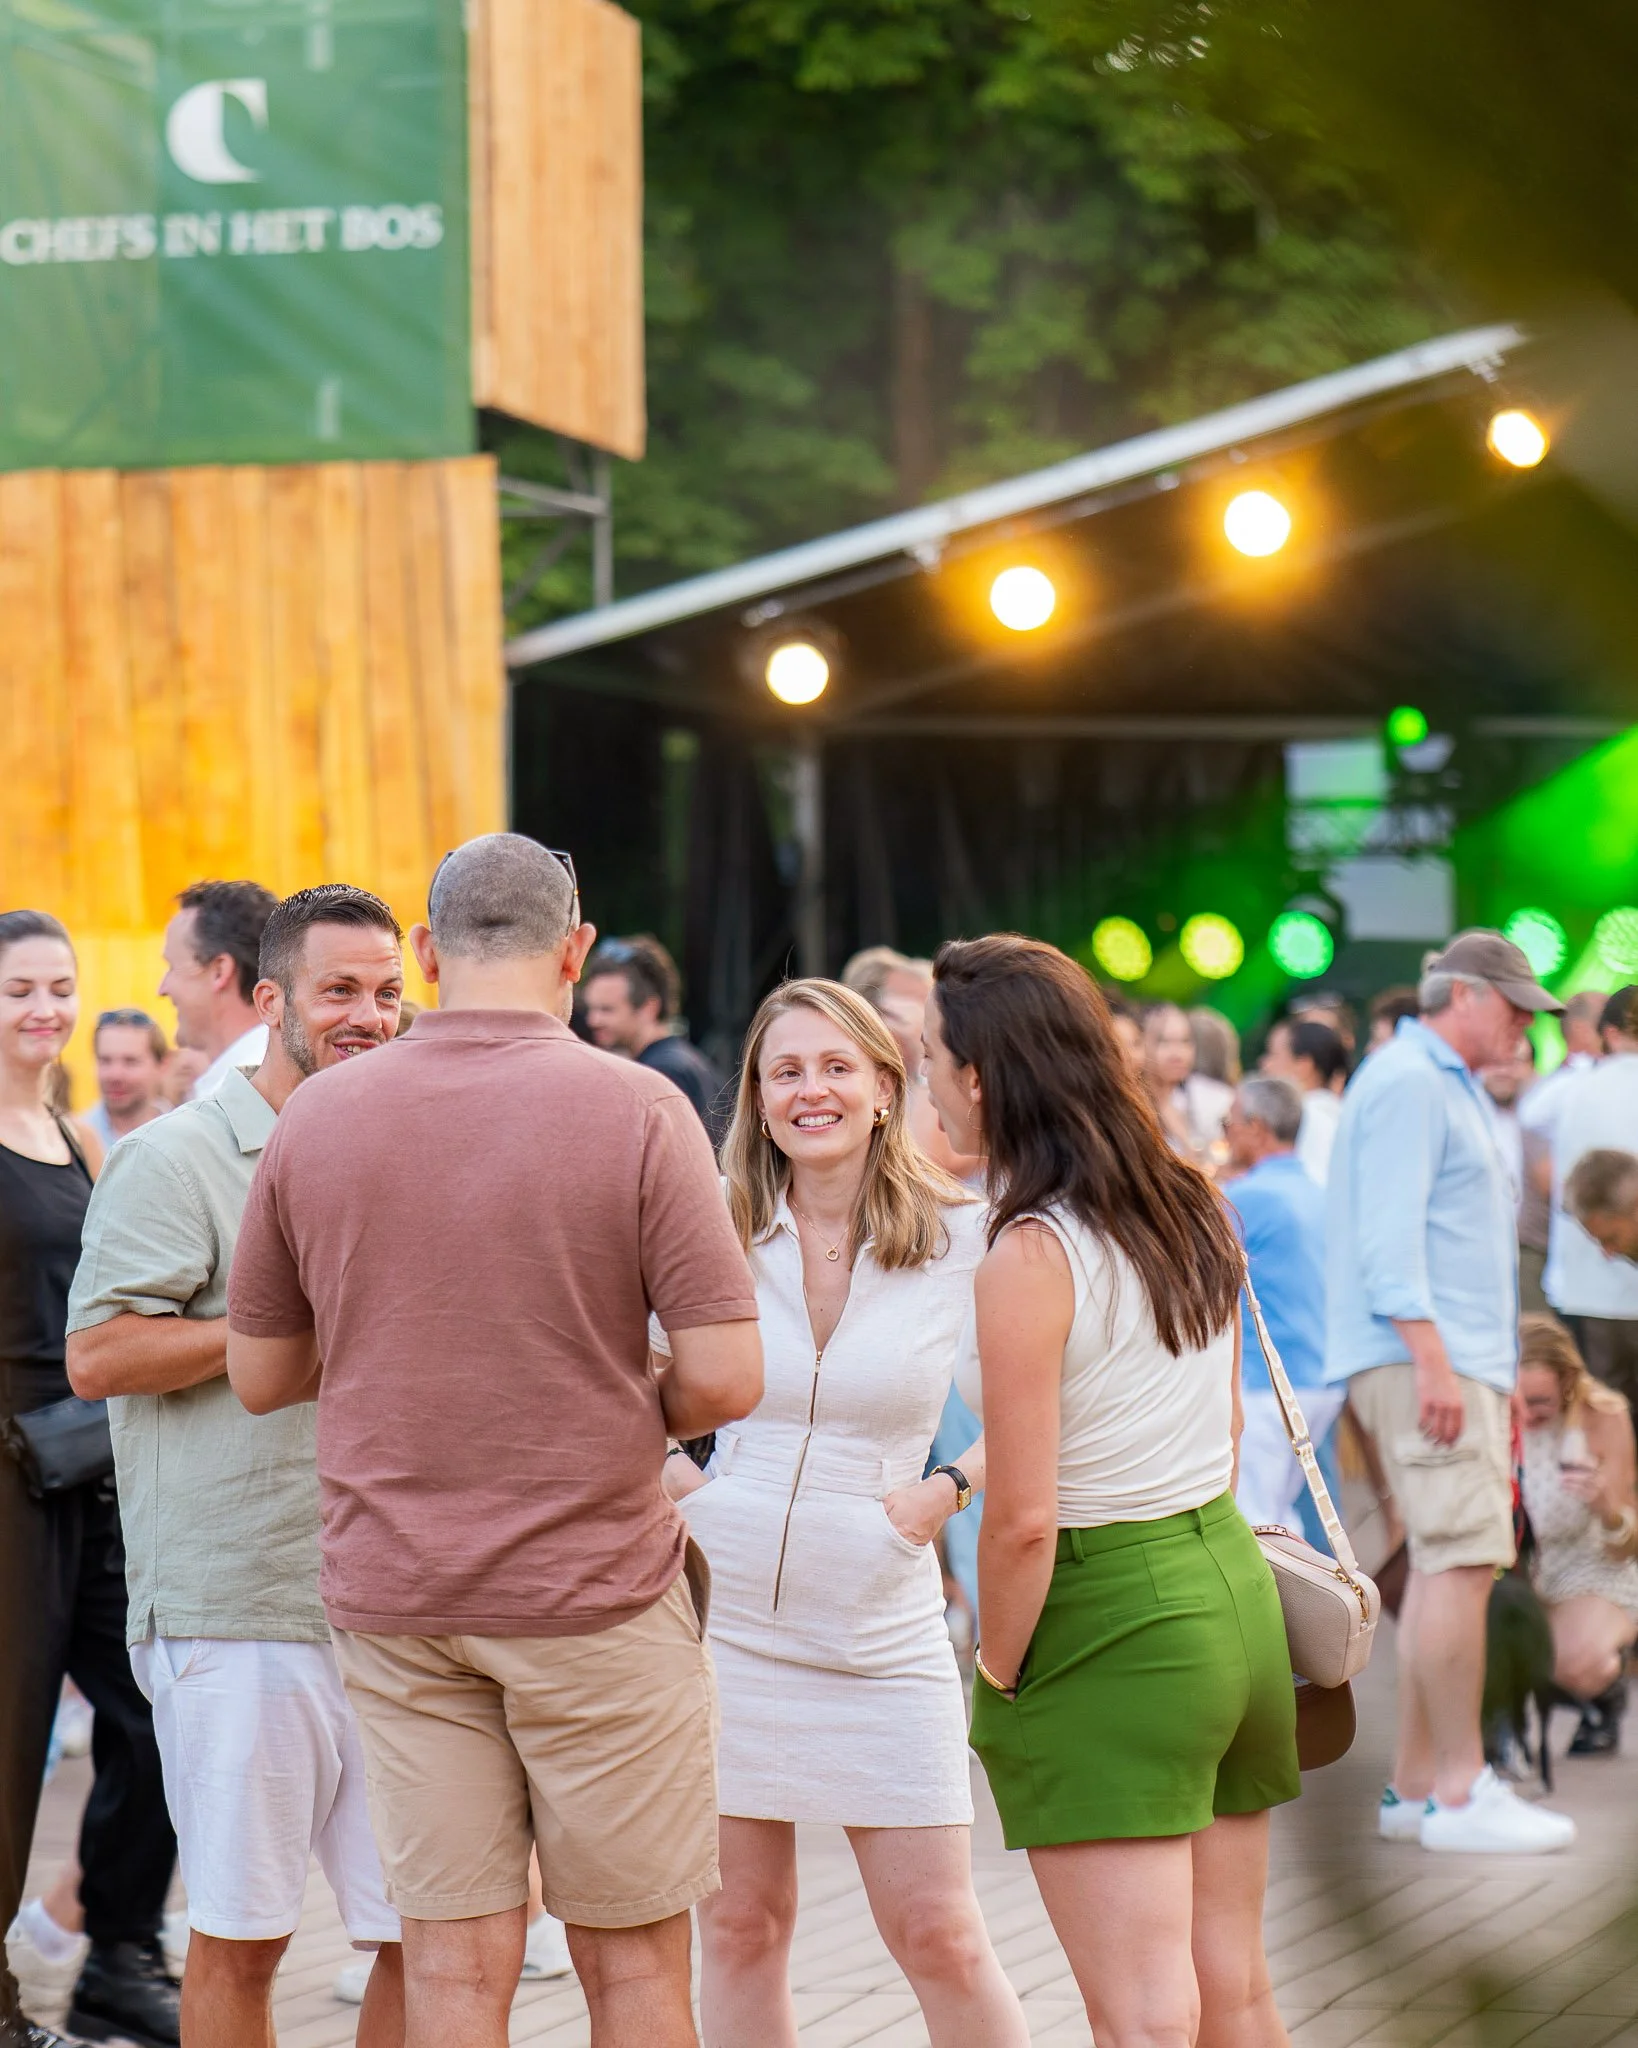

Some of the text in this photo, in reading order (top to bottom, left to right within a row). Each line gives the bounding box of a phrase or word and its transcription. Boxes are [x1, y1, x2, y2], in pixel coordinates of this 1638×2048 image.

[167, 79, 269, 184] C
[0, 203, 444, 265] CHEFS IN HET BOS
